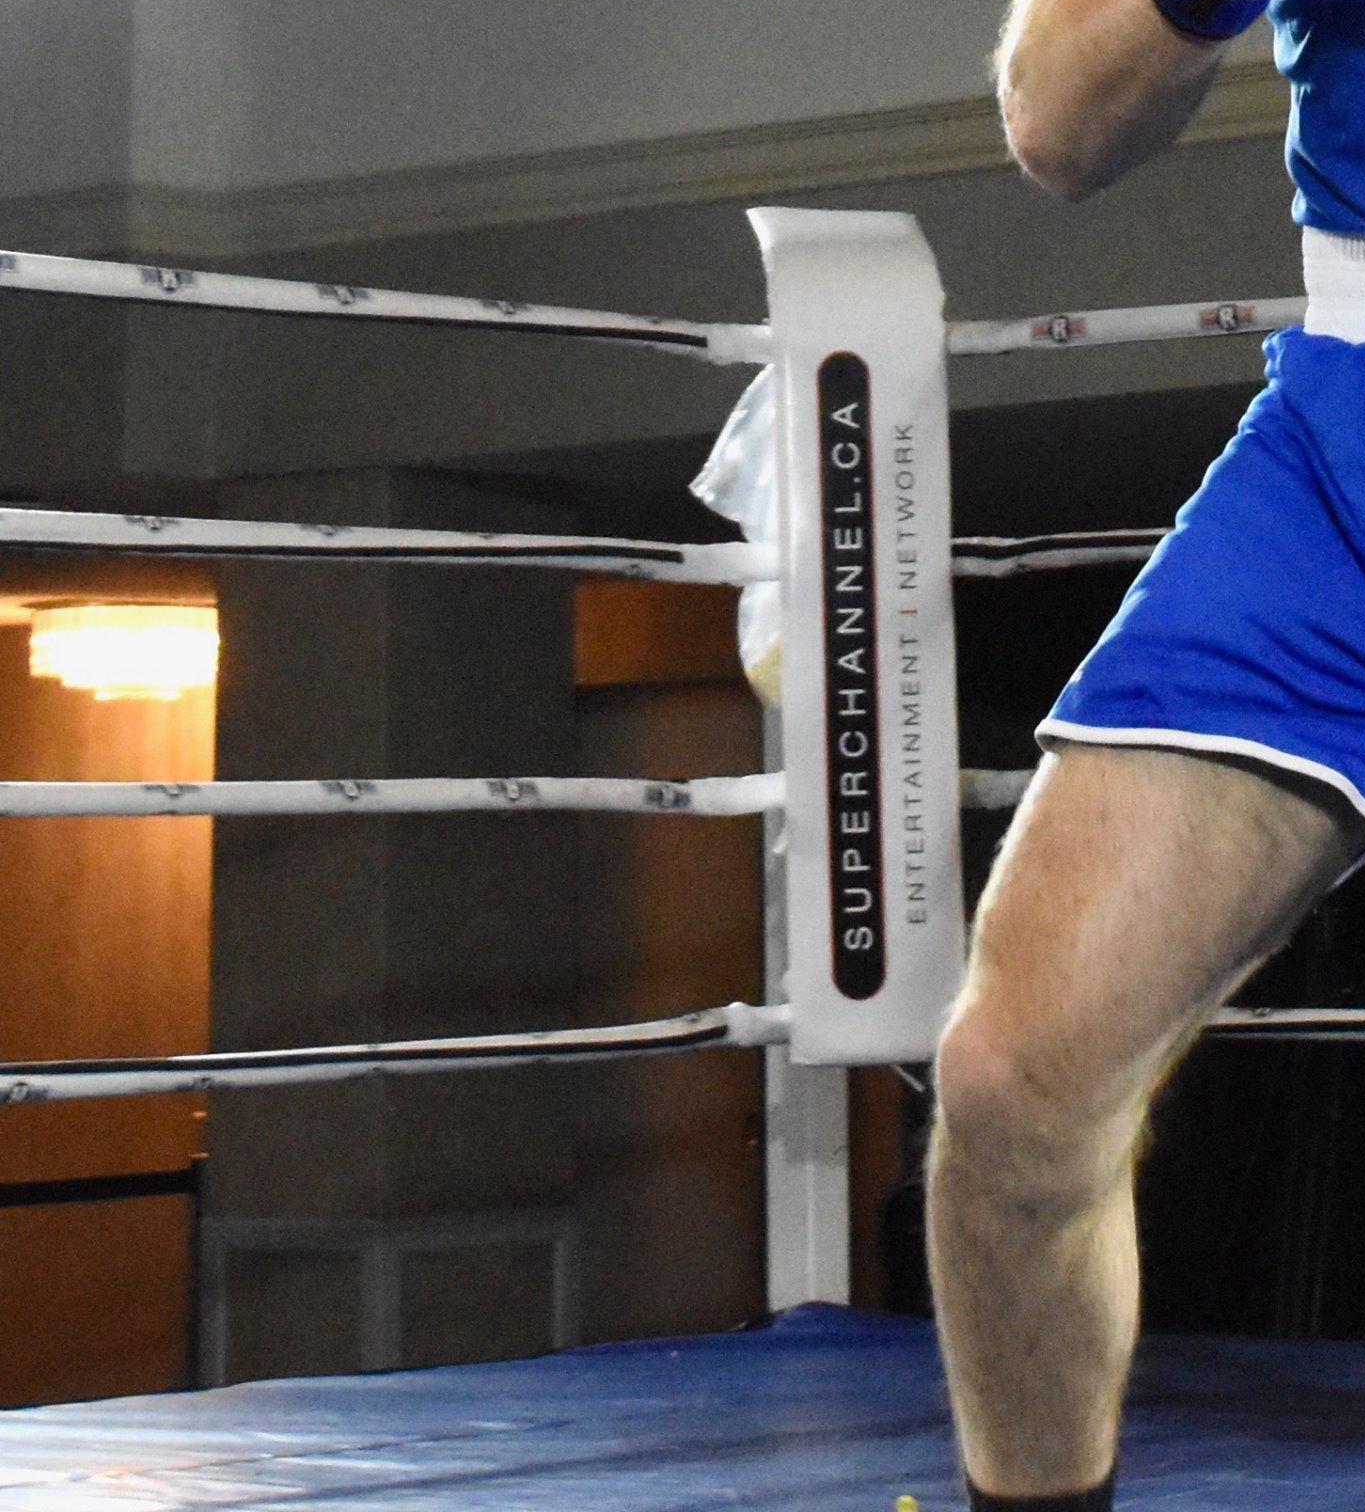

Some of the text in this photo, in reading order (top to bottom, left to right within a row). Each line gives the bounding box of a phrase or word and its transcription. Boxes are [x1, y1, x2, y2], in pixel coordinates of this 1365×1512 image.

[893, 423, 919, 590] NETWORK
[831, 401, 875, 952] SUPERCHANNEL.CA
[901, 635, 927, 925] ENTERTAINMENT
